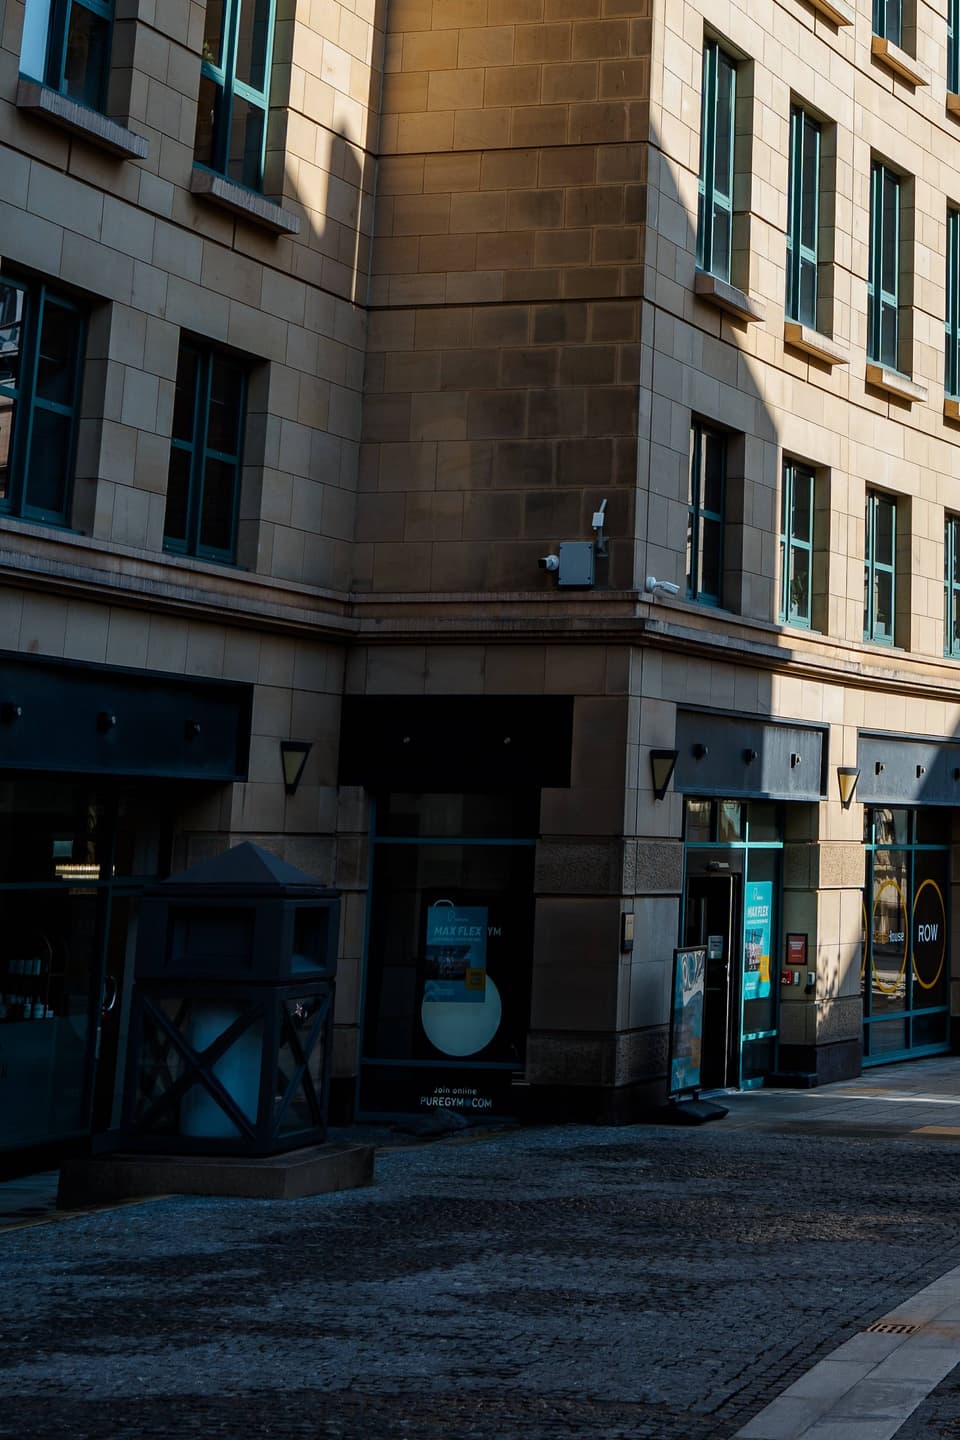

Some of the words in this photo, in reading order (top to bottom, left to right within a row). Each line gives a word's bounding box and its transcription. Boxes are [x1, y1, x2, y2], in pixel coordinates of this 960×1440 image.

[433, 926, 457, 936] MAX
[457, 926, 483, 937] FLEX
[918, 923, 939, 943] ROW
